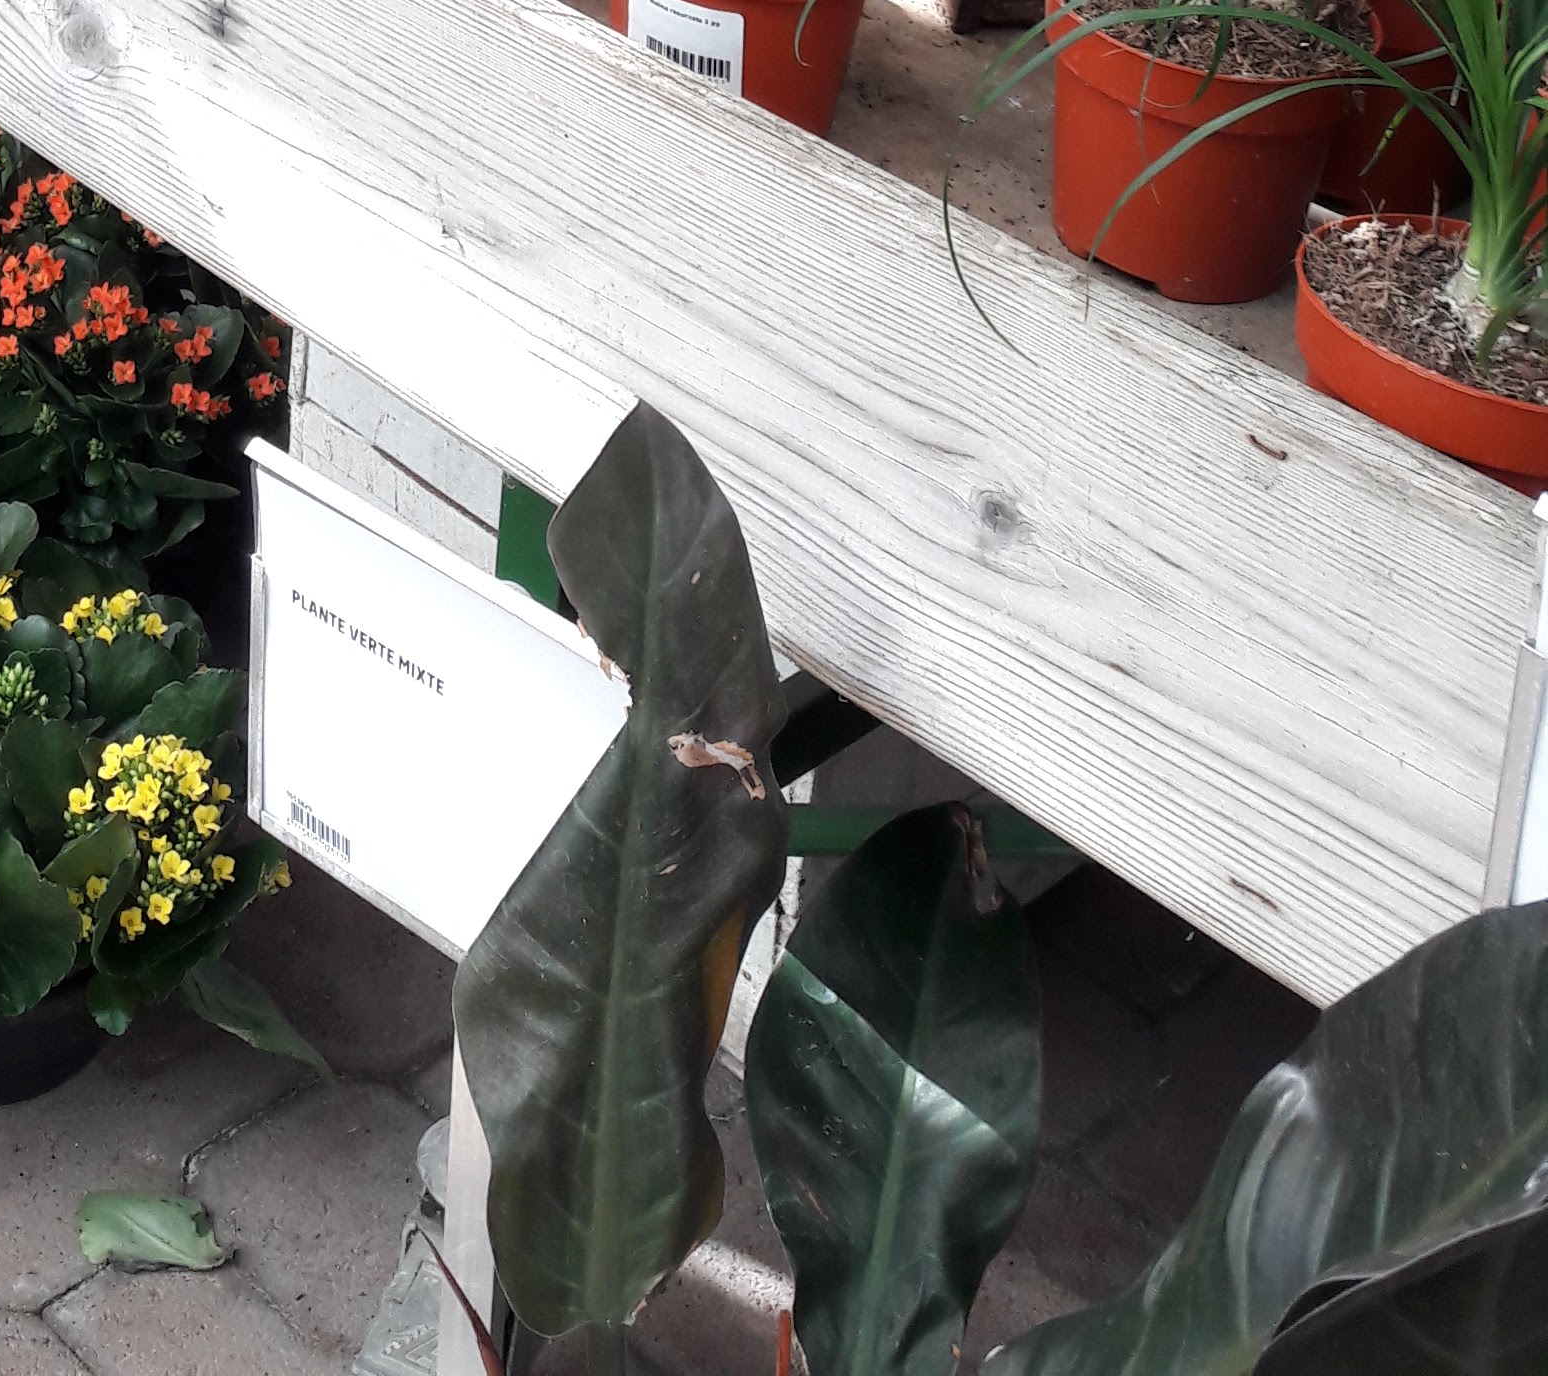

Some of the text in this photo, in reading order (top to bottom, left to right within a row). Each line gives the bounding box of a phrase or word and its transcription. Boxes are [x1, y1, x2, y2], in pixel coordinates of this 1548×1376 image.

[291, 588, 445, 697] PLANTE VERTE MIXTE
